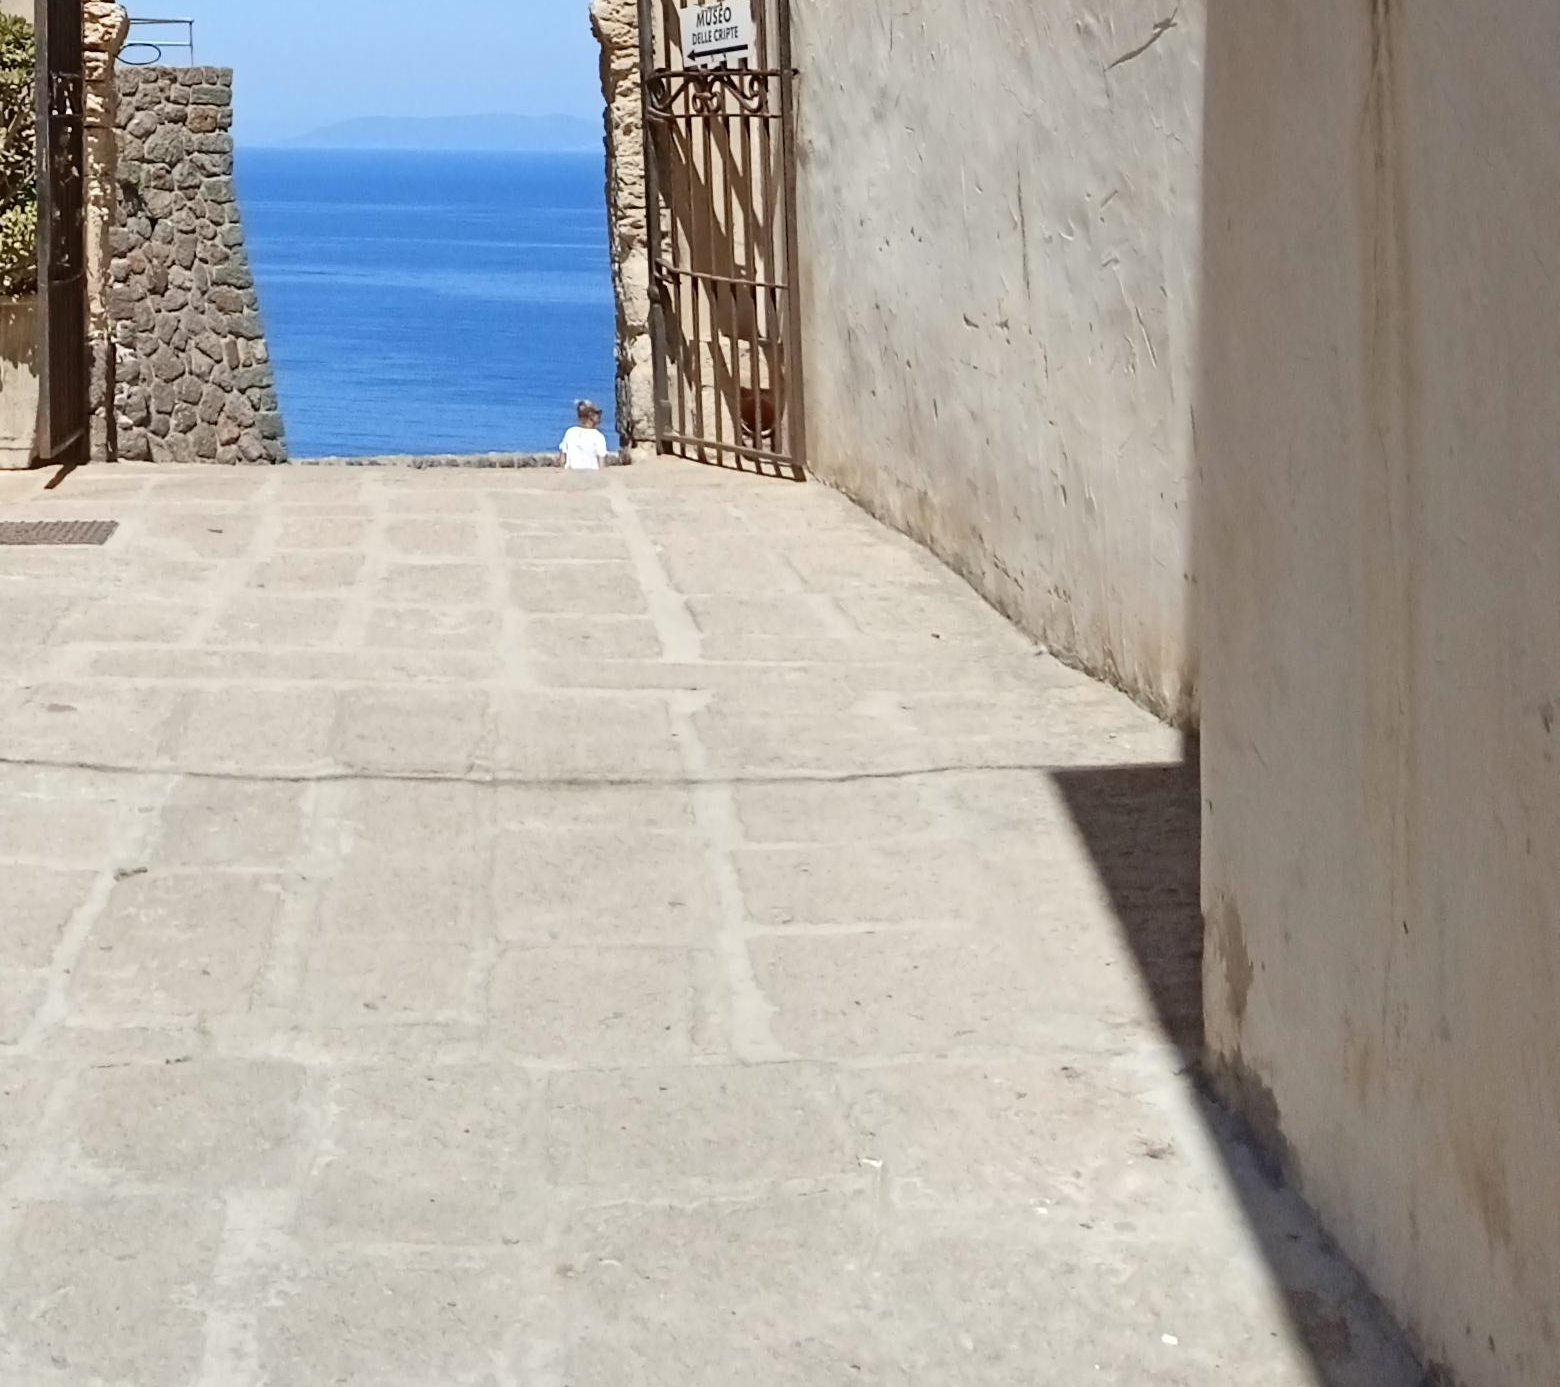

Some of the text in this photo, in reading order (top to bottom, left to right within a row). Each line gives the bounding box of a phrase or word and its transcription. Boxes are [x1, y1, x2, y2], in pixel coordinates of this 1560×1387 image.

[696, 7, 732, 28] MUSEO
[692, 26, 739, 46] DELLE CRIPTE
